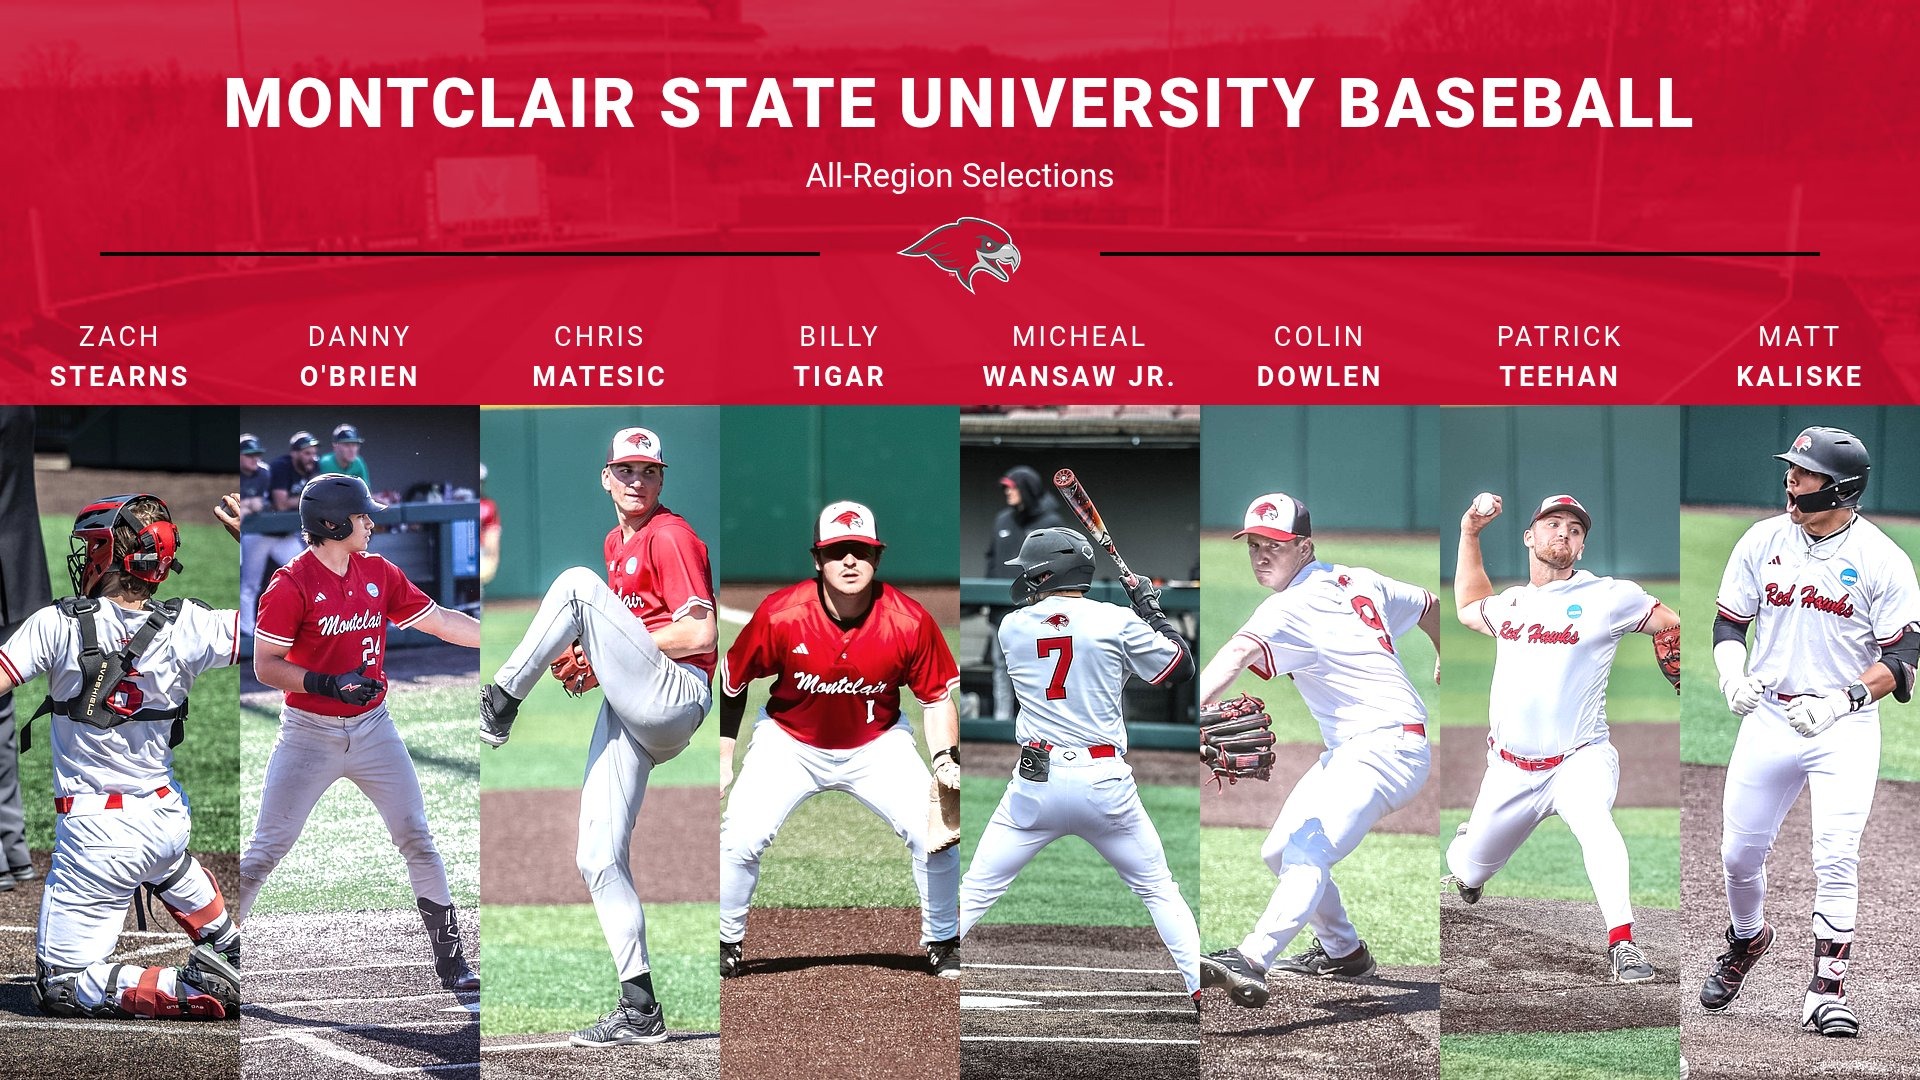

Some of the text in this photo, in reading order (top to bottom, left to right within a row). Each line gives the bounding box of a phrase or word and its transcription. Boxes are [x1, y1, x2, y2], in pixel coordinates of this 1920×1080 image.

[1765, 582, 1854, 618] Red Hawks
[1500, 620, 1580, 645] Red Hawks
[793, 671, 888, 695] Montclair
[1037, 635, 1073, 701] 7
[86, 661, 108, 716] EVOSHIELD
